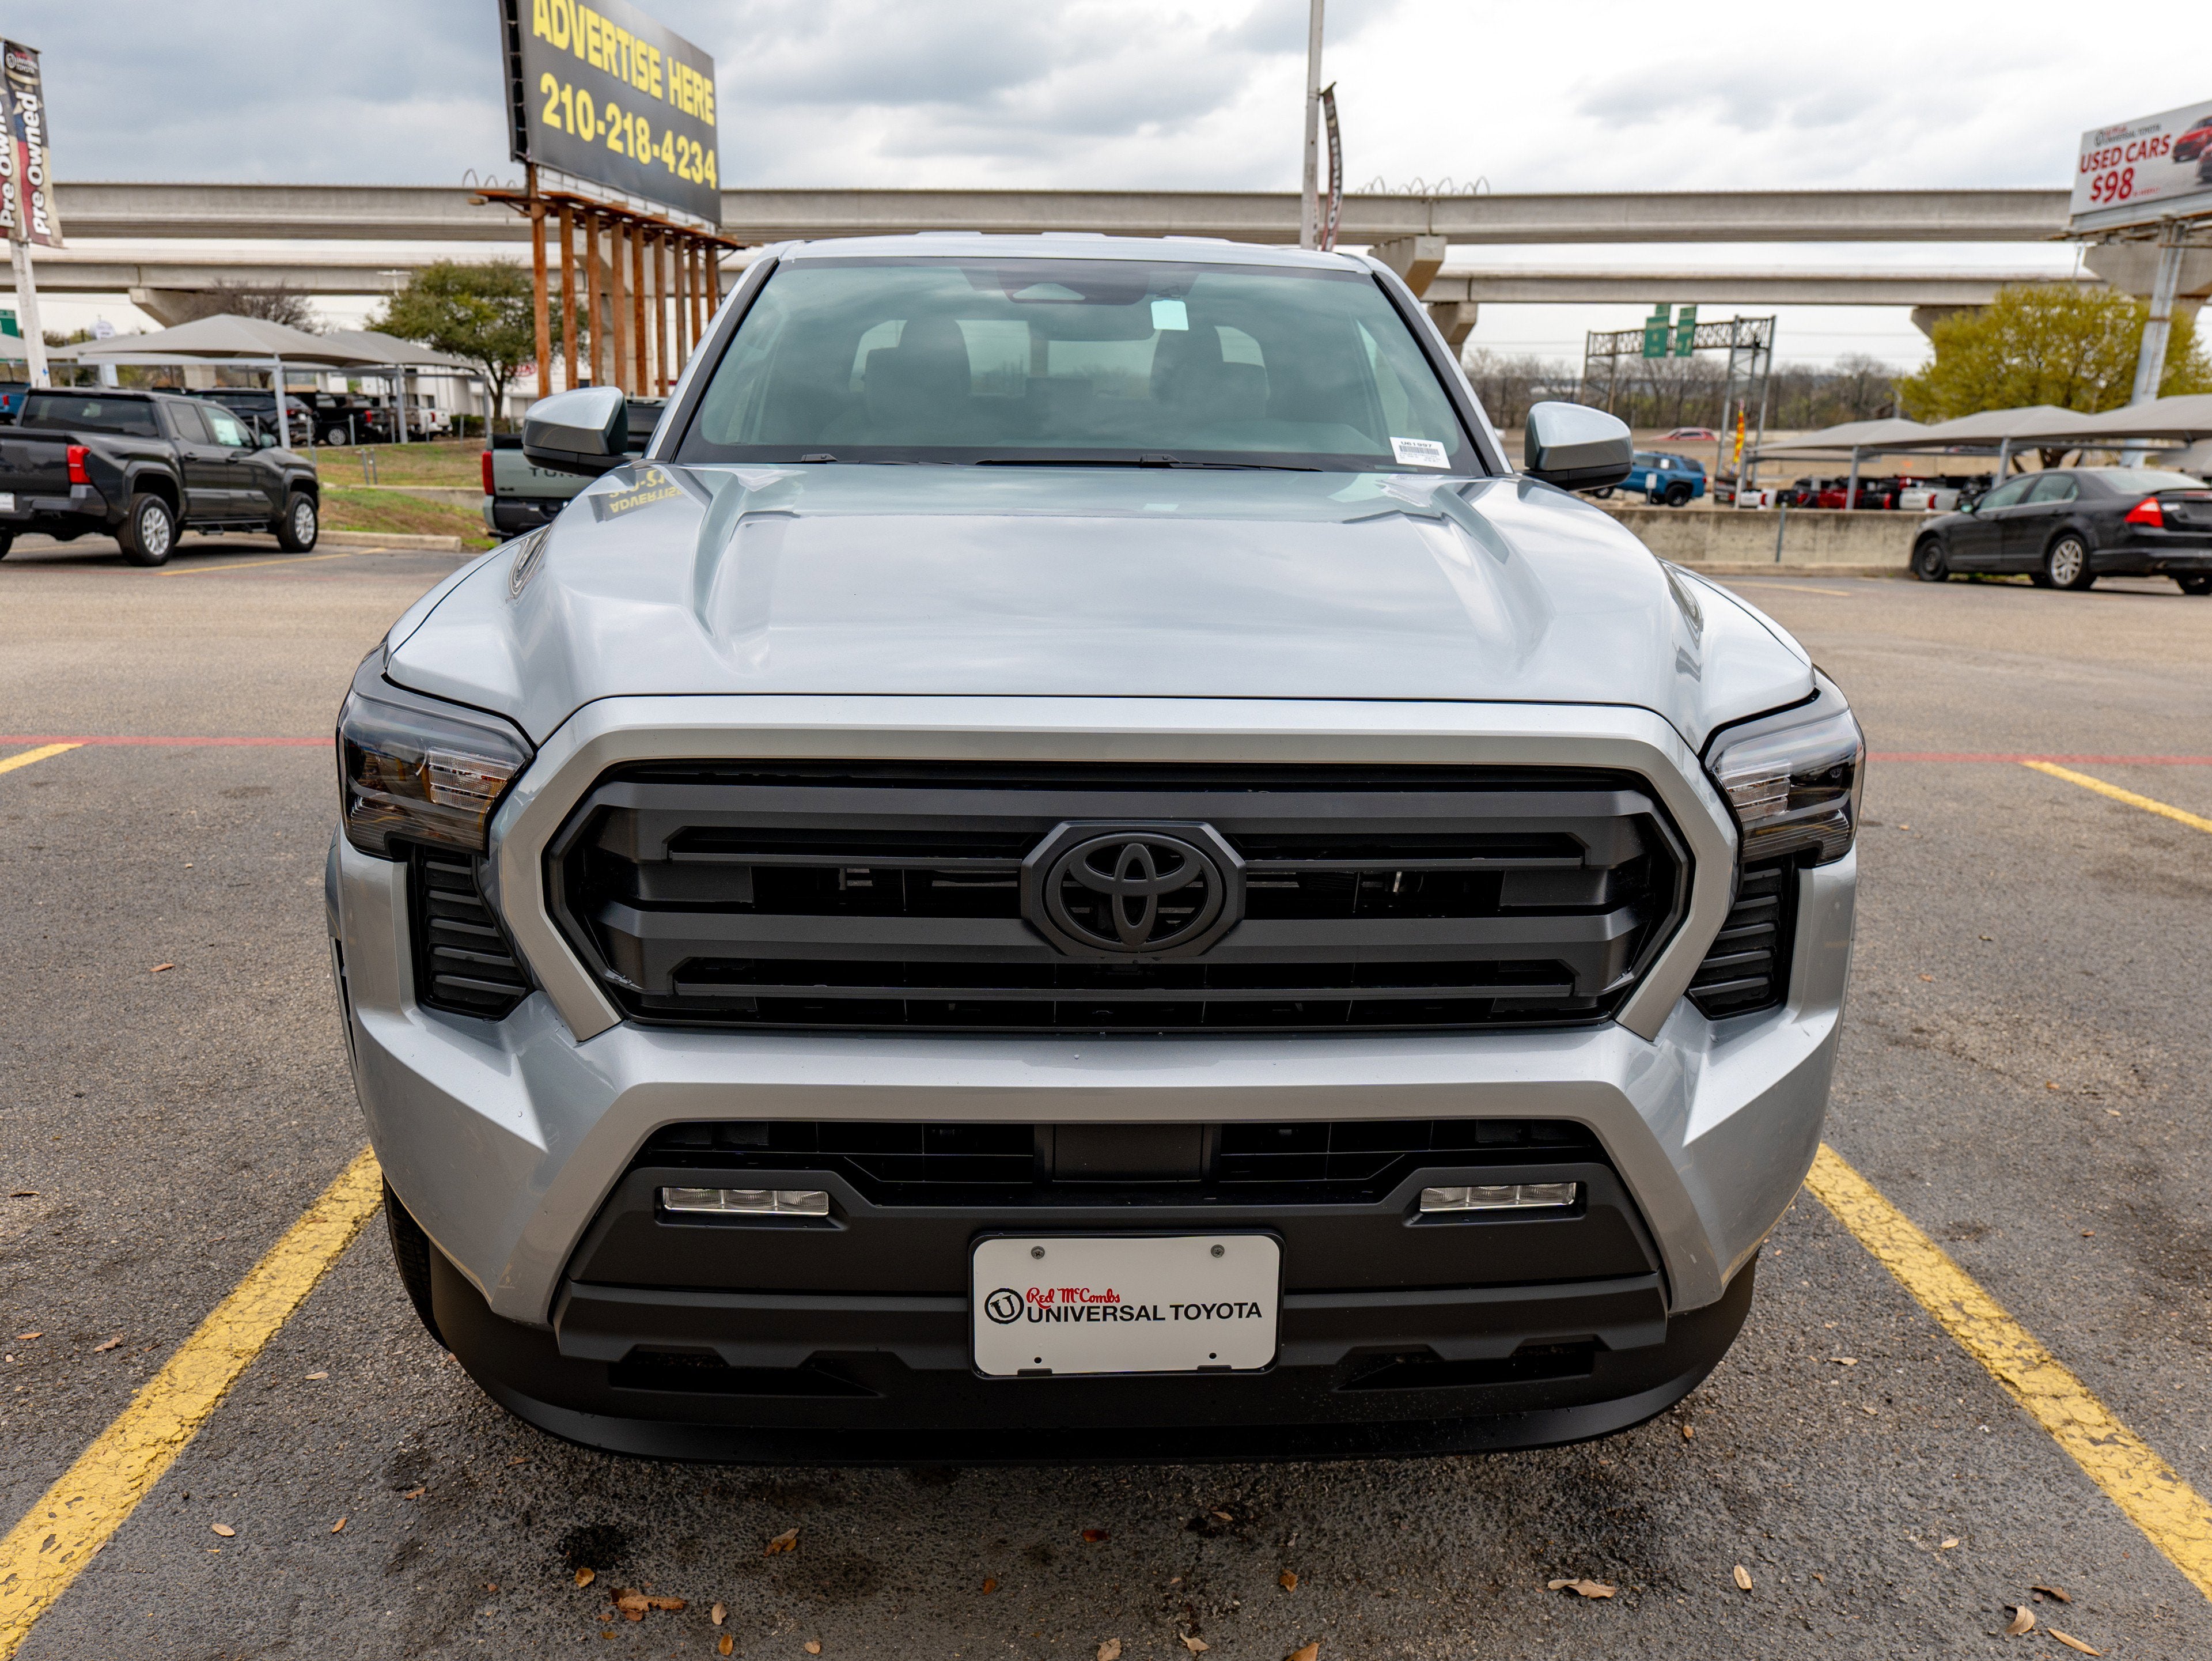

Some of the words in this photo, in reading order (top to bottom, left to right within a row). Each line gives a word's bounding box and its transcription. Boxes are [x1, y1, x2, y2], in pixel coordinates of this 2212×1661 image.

[533, 0, 663, 100] ADVERTISE
[667, 55, 715, 127] HERE
[15, 91, 44, 186] Owned
[540, 72, 717, 190] 210-218-4234
[2080, 147, 2122, 173] USED
[2126, 134, 2171, 162] CARS
[2090, 168, 2134, 203] $98
[1027, 1287, 1055, 1310] Red
[1057, 1288, 1120, 1303] McCombs
[1027, 1304, 1166, 1323] UNIVERSAL
[1170, 1302, 1263, 1321] TOYOTA
